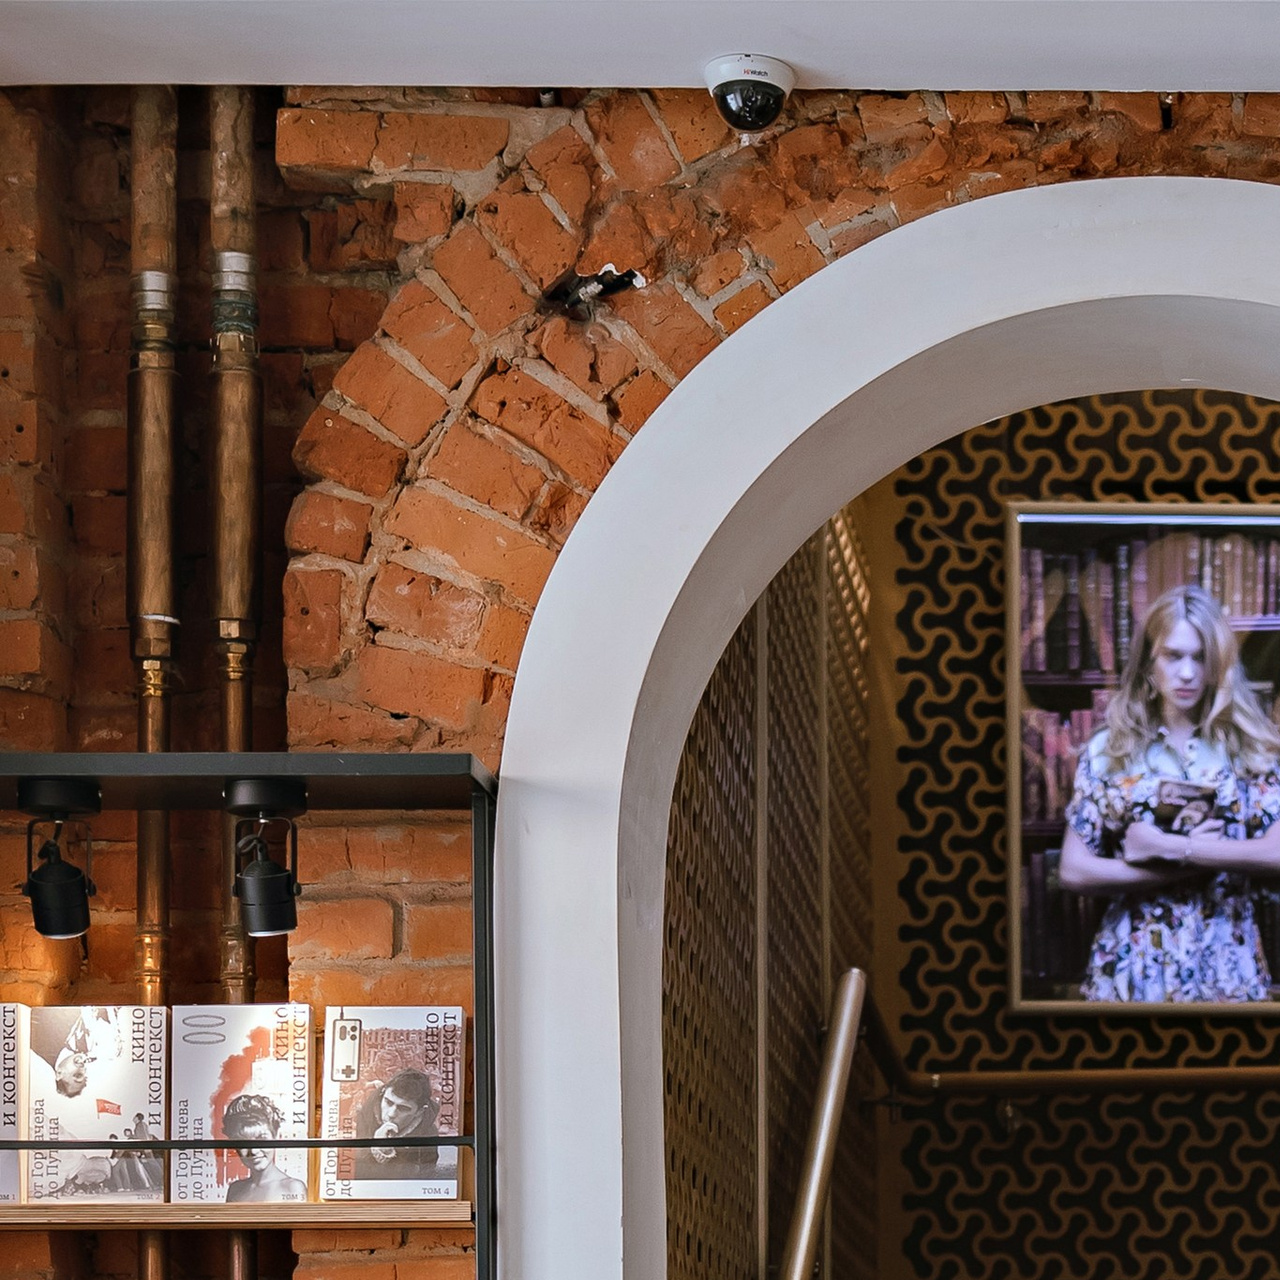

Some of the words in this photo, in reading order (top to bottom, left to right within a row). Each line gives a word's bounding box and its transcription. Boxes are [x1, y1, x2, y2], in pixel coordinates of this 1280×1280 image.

[132, 1008, 146, 1063] КИНО
[275, 1008, 289, 1062] КИНО
[425, 1012, 440, 1067] КИНО
[32, 1099, 47, 1177] Горачева
[176, 1099, 191, 1177] Горачева
[325, 1099, 339, 1177] Горачева
[176, 1183, 188, 1200] от
[191, 1182, 205, 1200] до
[325, 1179, 336, 1196] от
[443, 1187, 450, 1195] 4
